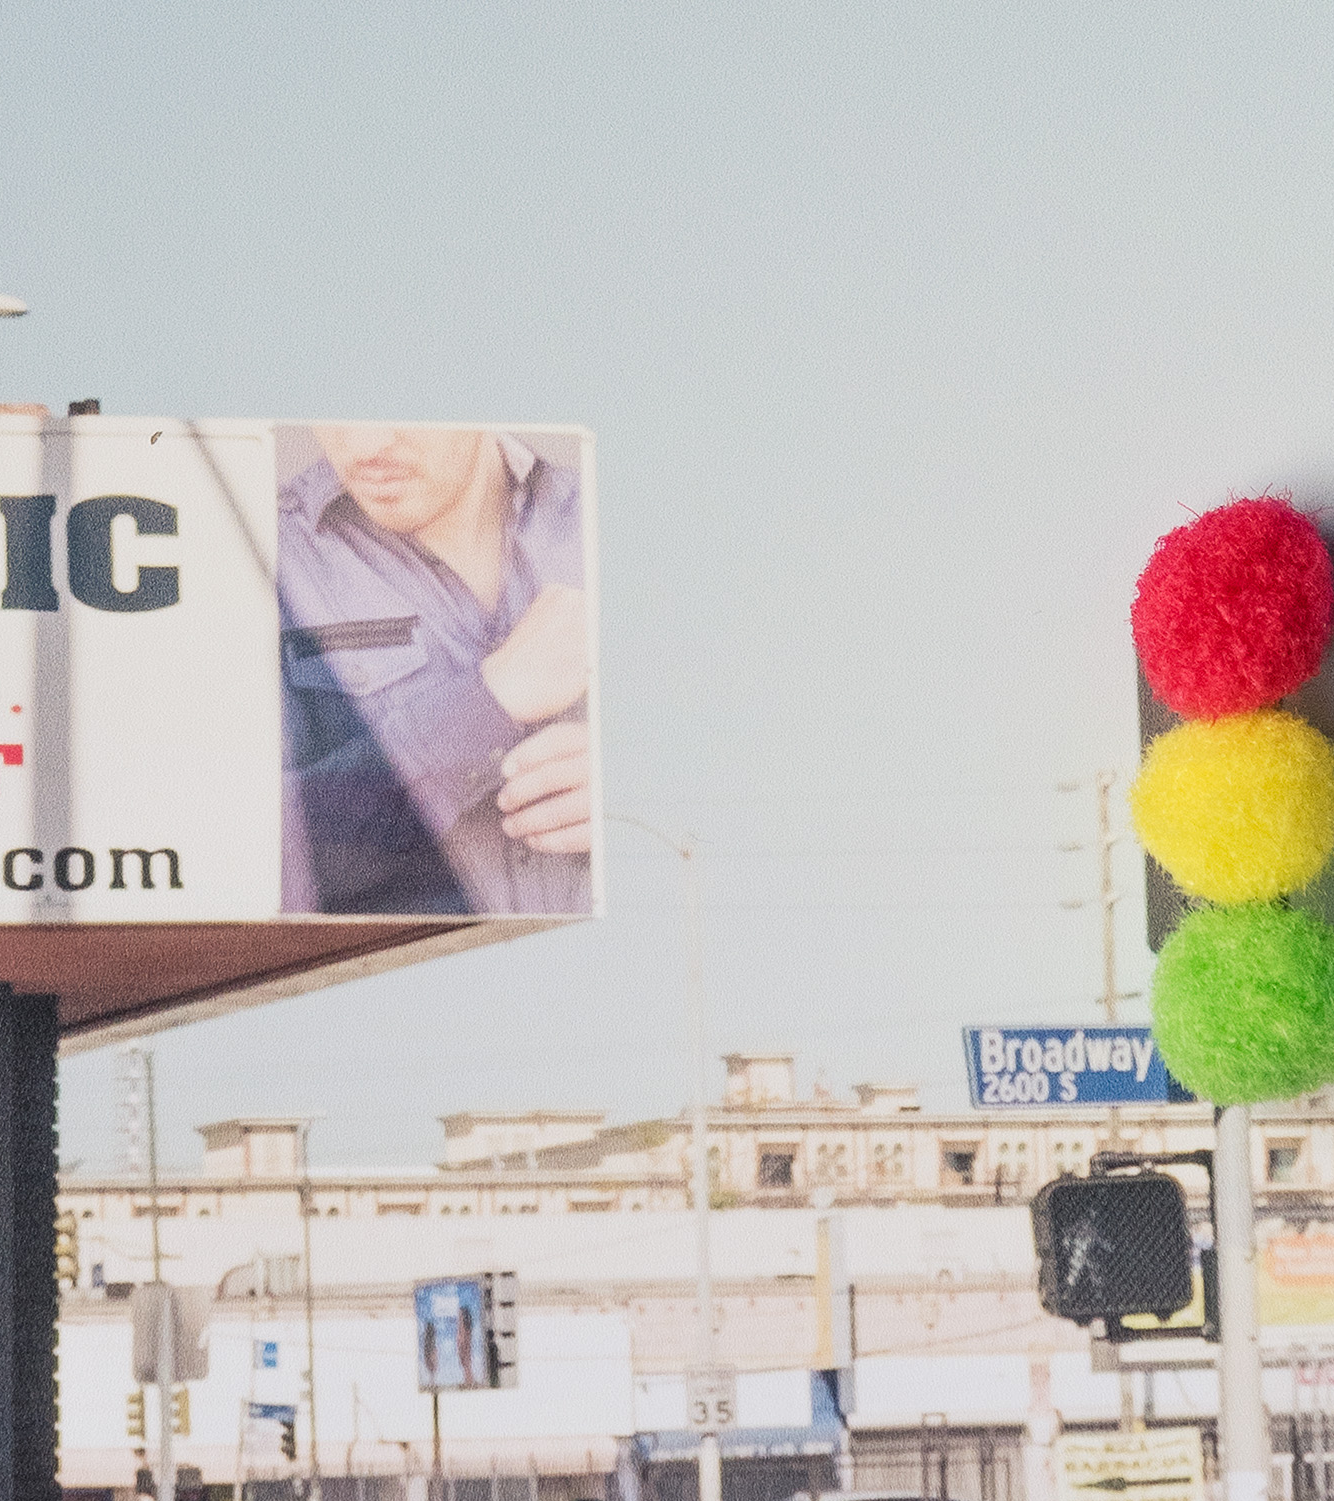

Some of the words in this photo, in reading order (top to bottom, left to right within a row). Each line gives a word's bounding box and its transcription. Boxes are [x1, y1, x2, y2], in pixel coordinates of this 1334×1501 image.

[979, 1028, 1154, 1082] Broadway
[982, 1073, 1050, 1103] 2600
[1060, 1072, 1078, 1101] S
[692, 1400, 734, 1425] 35
